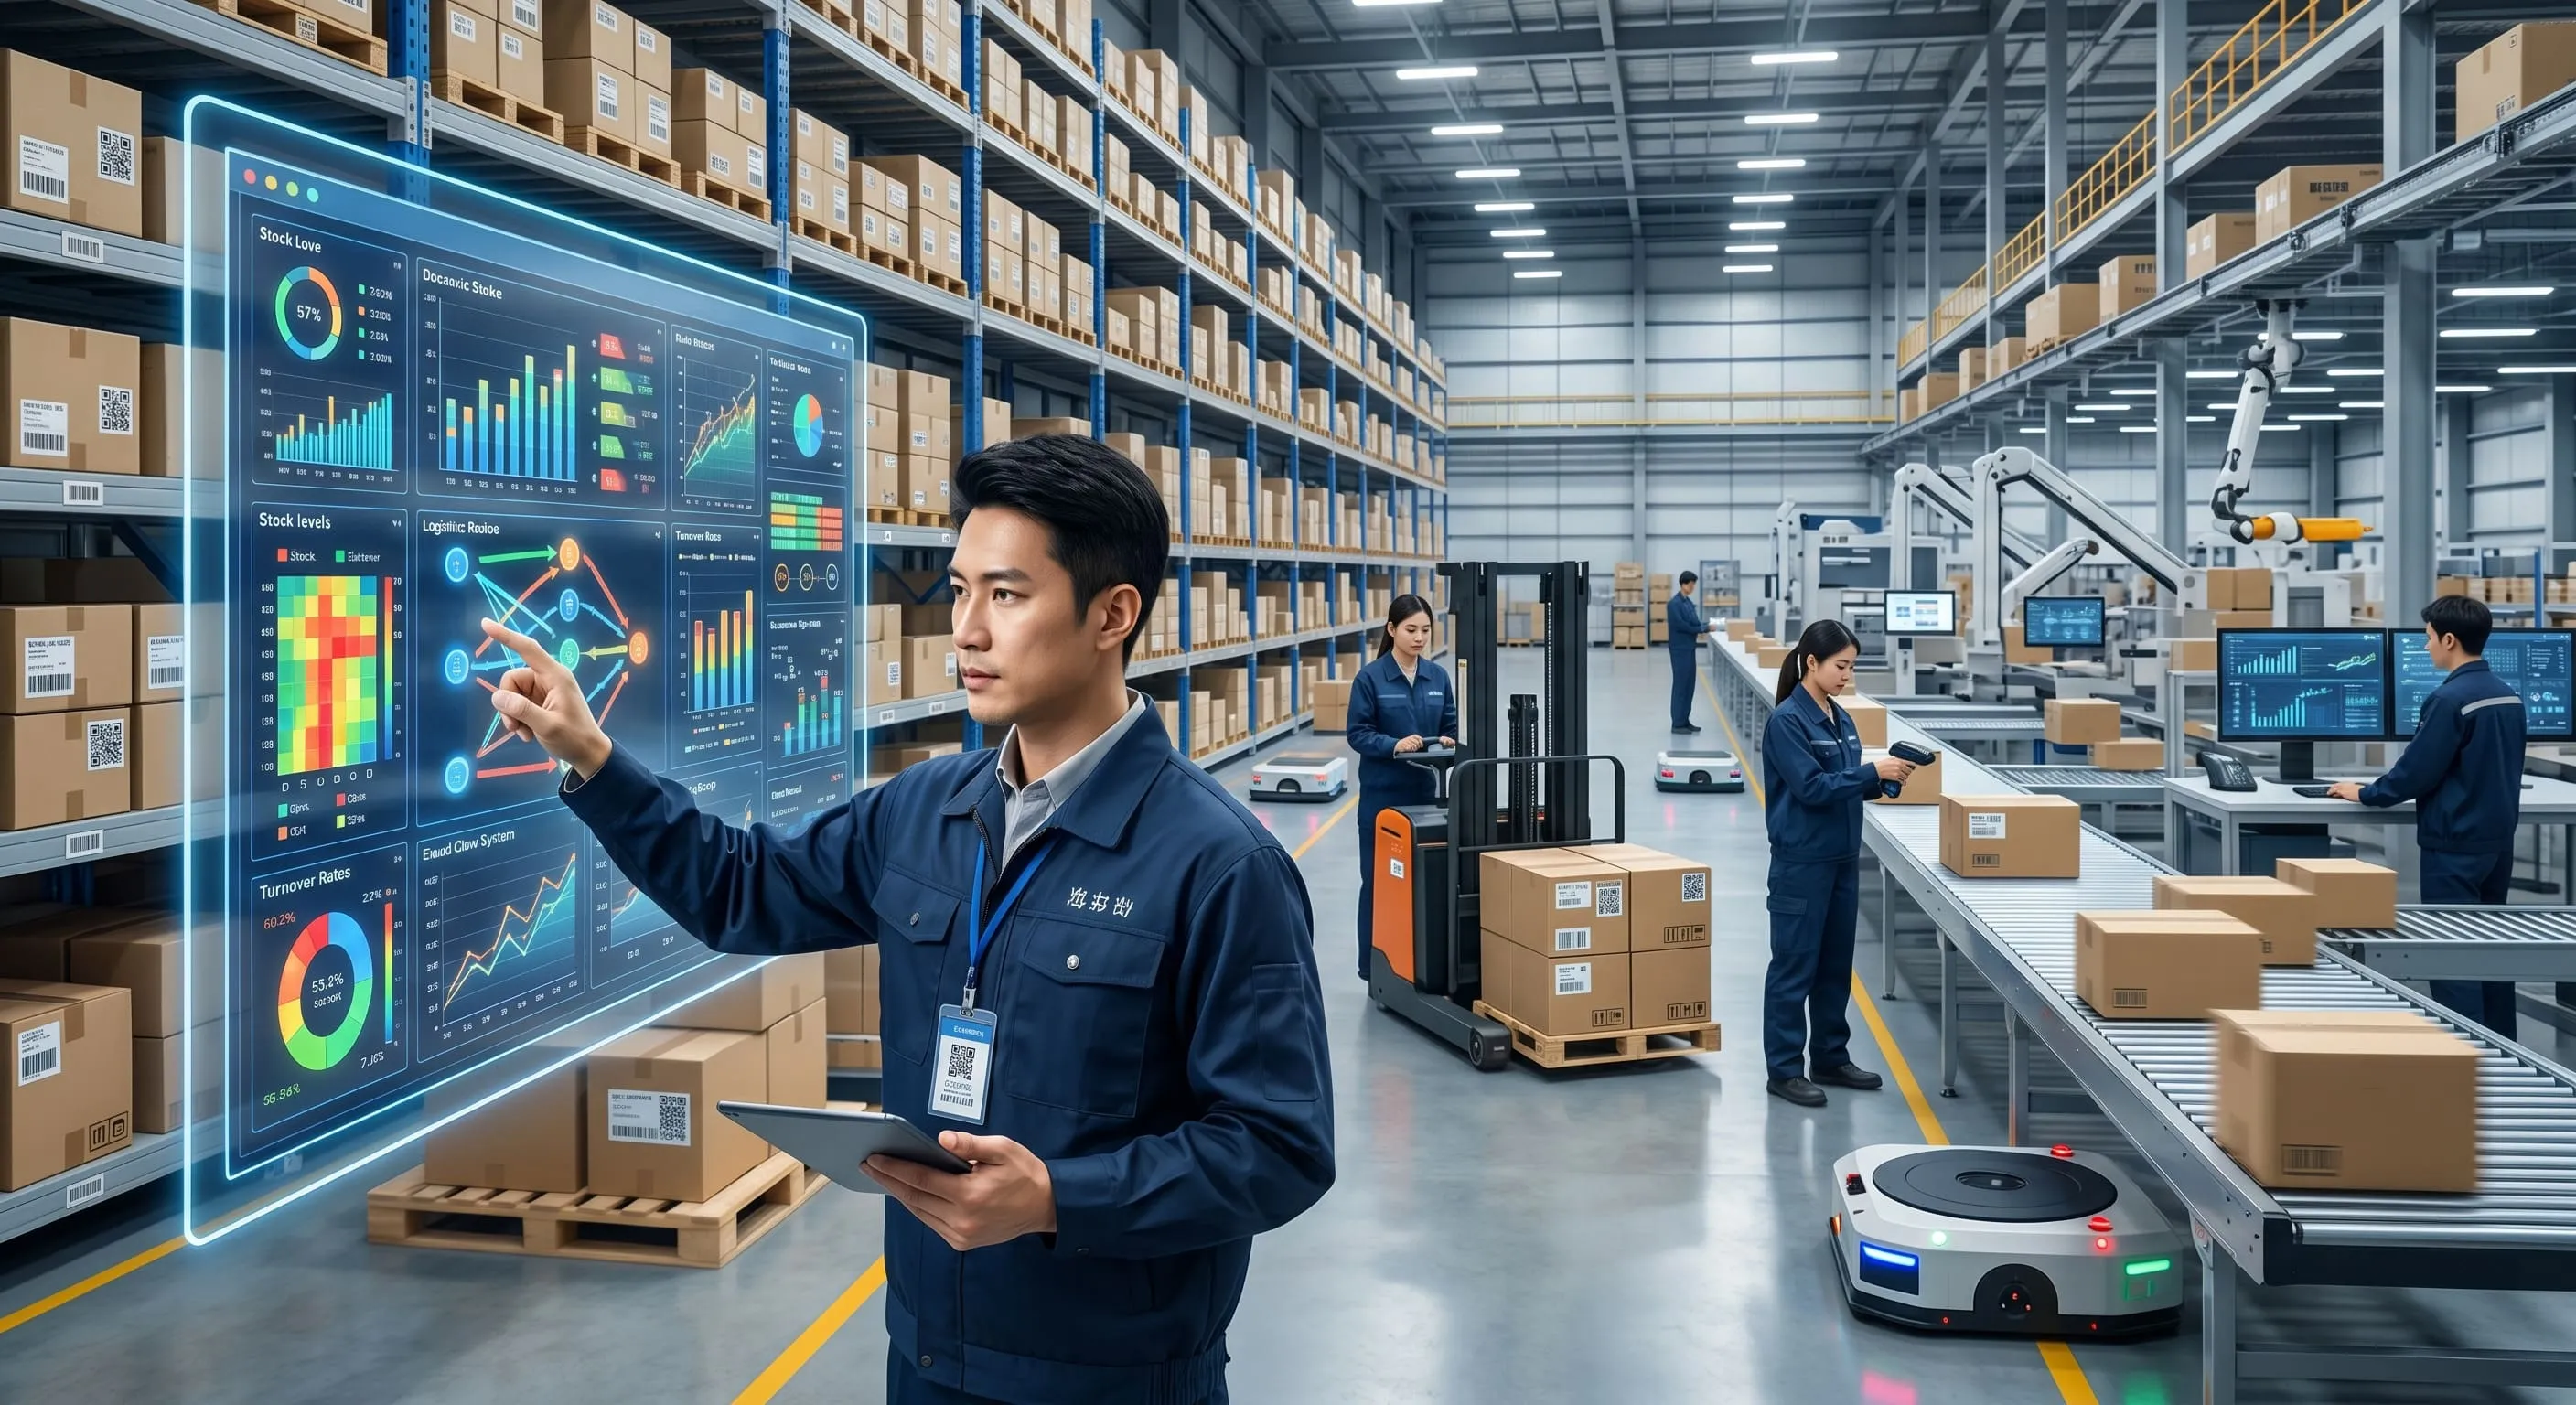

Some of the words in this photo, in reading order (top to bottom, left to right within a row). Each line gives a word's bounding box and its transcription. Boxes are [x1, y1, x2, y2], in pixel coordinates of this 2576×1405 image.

[260, 226, 293, 247] Stock
[295, 235, 322, 253] Love
[472, 281, 502, 299] Stoke
[296, 305, 322, 322] 57%
[259, 512, 294, 527] Stock
[297, 513, 331, 529] levels
[290, 551, 316, 562] Stock
[480, 831, 515, 848] System
[260, 876, 316, 900] Turnover
[319, 867, 351, 885] Rates
